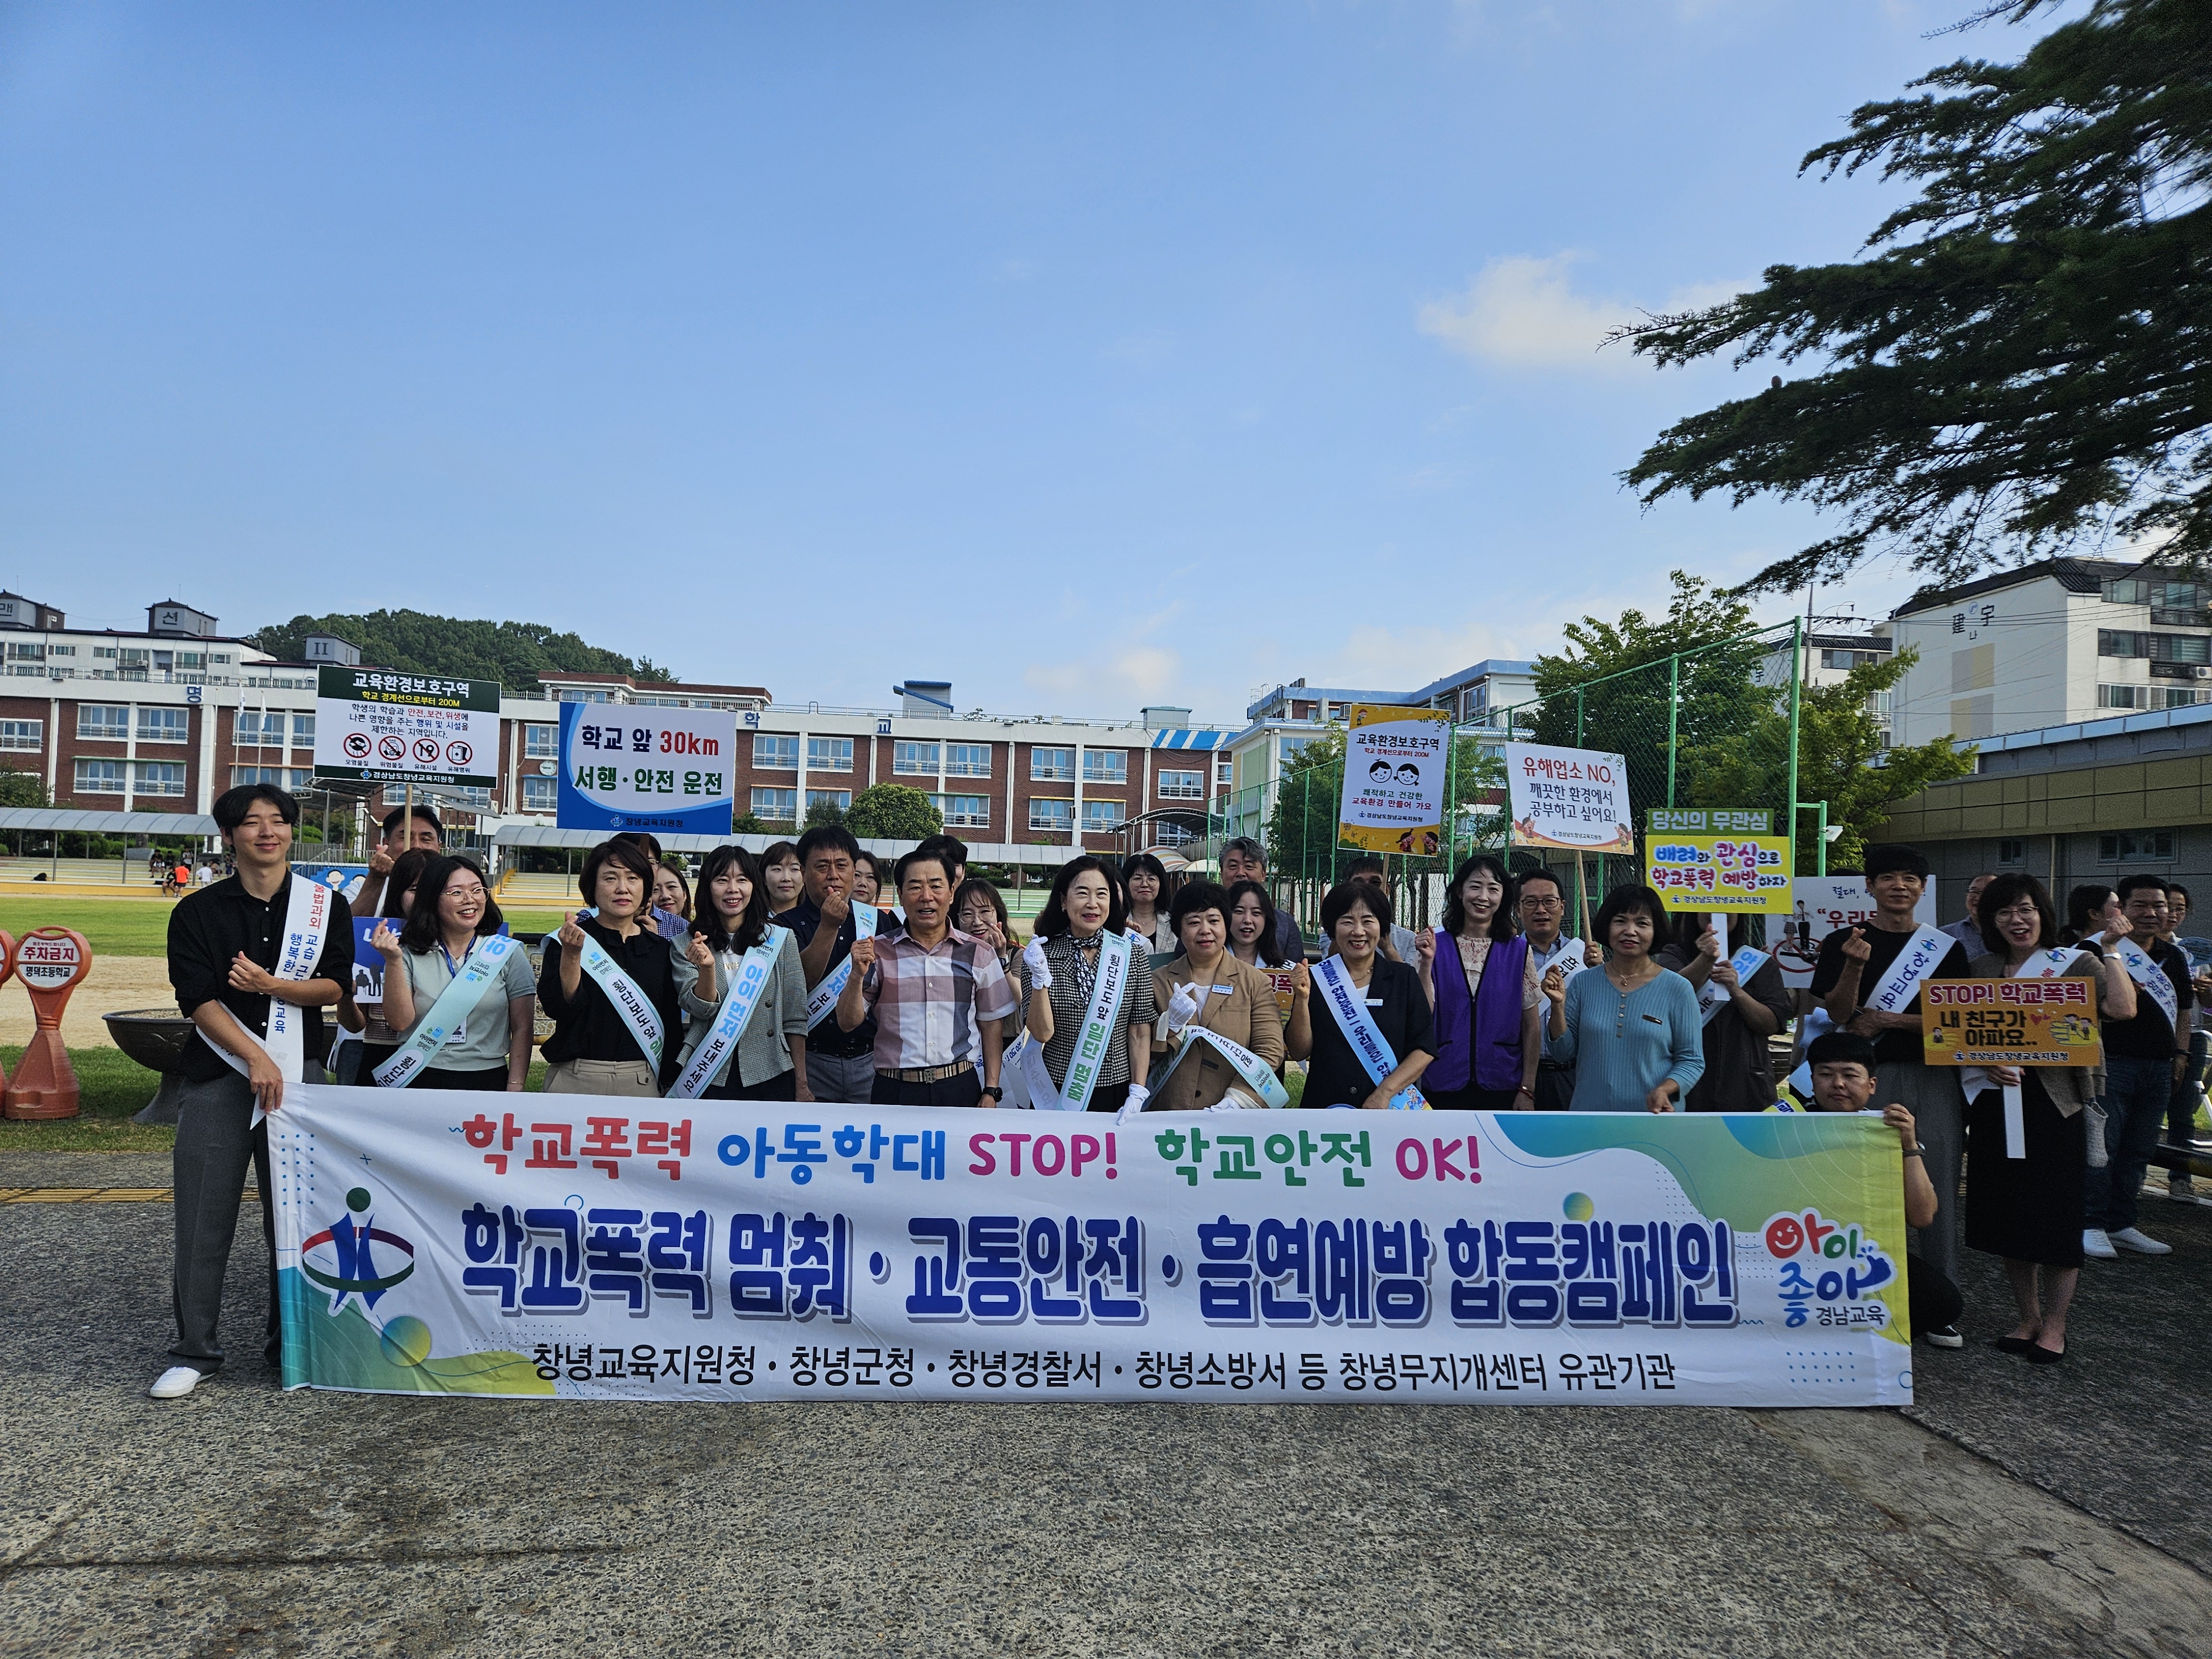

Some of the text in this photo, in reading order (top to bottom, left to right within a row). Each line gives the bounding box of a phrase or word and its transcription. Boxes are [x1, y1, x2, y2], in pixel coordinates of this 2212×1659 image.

[163, 611, 178, 625] 션
[352, 672, 469, 698] 교육환경보호구역
[187, 686, 891, 734] 명 학 교
[352, 703, 376, 714] 학생의
[380, 706, 405, 716] 학습과
[362, 691, 460, 707] 학교 경계선으로부터 200M
[349, 713, 469, 732] 나쁜 영향을 주는 행위 및 시설을
[371, 725, 448, 739] 제한하는 지역입니다.
[582, 725, 719, 756] 학교 앞 30km
[1356, 733, 1439, 750] 교육환경보호구역
[1377, 748, 1412, 758] 경계선으로부터
[373, 771, 455, 784] 경상남도창녕교육지원청
[1522, 757, 1615, 786] 유해업소 NO,
[683, 771, 722, 795] 운전
[1352, 797, 1384, 807] 교육환경
[1388, 800, 1412, 809] 만들어
[1363, 789, 1423, 800] 쾌적하고 건강한
[1530, 783, 1613, 806] 깨끗한 환경에서
[625, 817, 683, 828] 창녕교육지원청
[1367, 812, 1423, 822] 경상남도창녕교육지원청
[1530, 801, 1616, 823] 공부하고 싶어요!
[1652, 811, 1768, 831] 당신의 무관심
[1655, 842, 1780, 868] 배려와 관심으로
[1651, 867, 1787, 890] 학교폭력 예방하자
[293, 885, 326, 981] 불법과외 교습 근
[24, 947, 74, 961] 주차금지
[283, 933, 302, 973] 행복한
[758, 944, 774, 953] 이먼저
[26, 966, 70, 977] 명덕초등학교
[592, 958, 609, 971] 아이먼저
[1929, 982, 2087, 1005] STOP! 학교폭력
[612, 979, 650, 1027] 횡단보도
[644, 1026, 656, 1040] 앞
[1940, 1010, 2027, 1028] 내 친구가
[684, 964, 763, 1093] 아이 먼저 보내주세요
[1067, 954, 1120, 1102] 횡단보도 앞 일단 멈춤
[462, 1113, 1482, 1187] 학교폭력 아동학대 STOP! 학교안전 OK!
[1766, 1213, 1861, 1259] 아이
[461, 1201, 713, 1318] 학교폭력
[728, 1210, 852, 1323] 멈춰
[905, 1214, 1146, 1326] 교통안전
[1197, 1214, 1437, 1328] 흡연예방
[1443, 1218, 1738, 1329] 합동캠페인
[1778, 1253, 1892, 1328] 좋아
[1816, 1306, 1886, 1326] 경남교육
[532, 1342, 755, 1386] 창녕교육지원청
[789, 1347, 914, 1387] 창녕군청
[948, 1349, 1102, 1389] 창녕경찰서
[1135, 1351, 1286, 1390] 창녕소방서
[1298, 1353, 1327, 1390] 등
[1339, 1353, 1547, 1391] 창녕무지개센터
[1559, 1353, 1676, 1391] 유관기관
